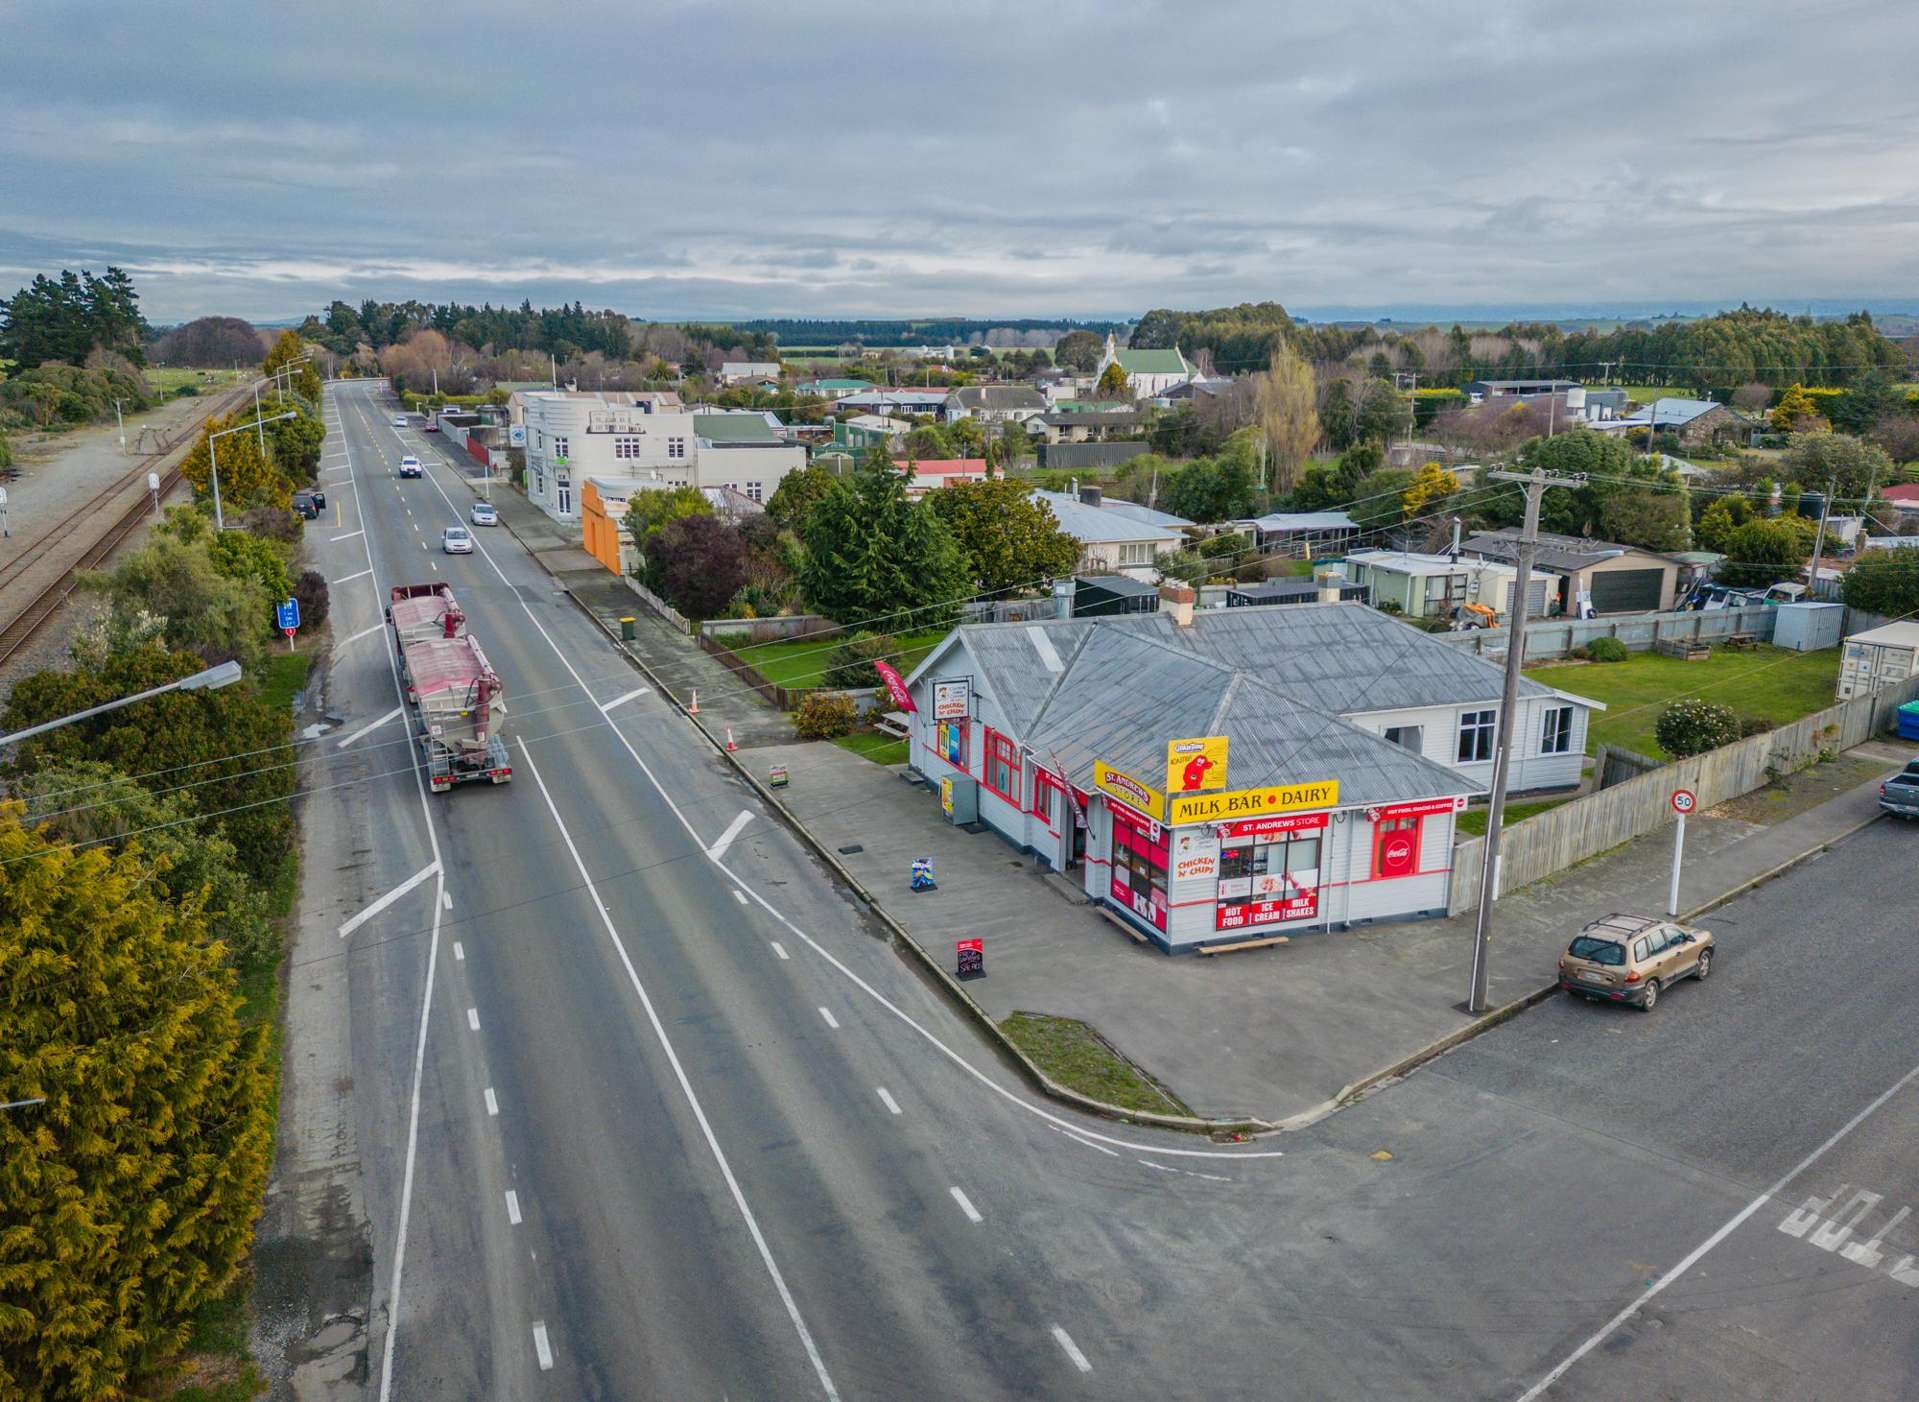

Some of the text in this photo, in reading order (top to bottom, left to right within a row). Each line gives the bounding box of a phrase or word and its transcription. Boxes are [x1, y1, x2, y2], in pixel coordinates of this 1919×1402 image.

[1116, 775, 1149, 803] ANDREWS
[1179, 787, 1330, 818] MILK BAR DAIRY
[1677, 795, 1691, 807] 50
[1256, 819, 1295, 830] ANDREWS
[1296, 817, 1320, 826] STORE
[1178, 857, 1215, 869] CHICKEN
[1190, 866, 1214, 875] CHIPS
[1261, 902, 1274, 912] ICE
[1291, 898, 1310, 908] MILK
[1225, 906, 1242, 916] HOT
[1254, 911, 1280, 922] CREAM
[1286, 906, 1314, 918] SHAKES
[1222, 916, 1244, 927] FOOD
